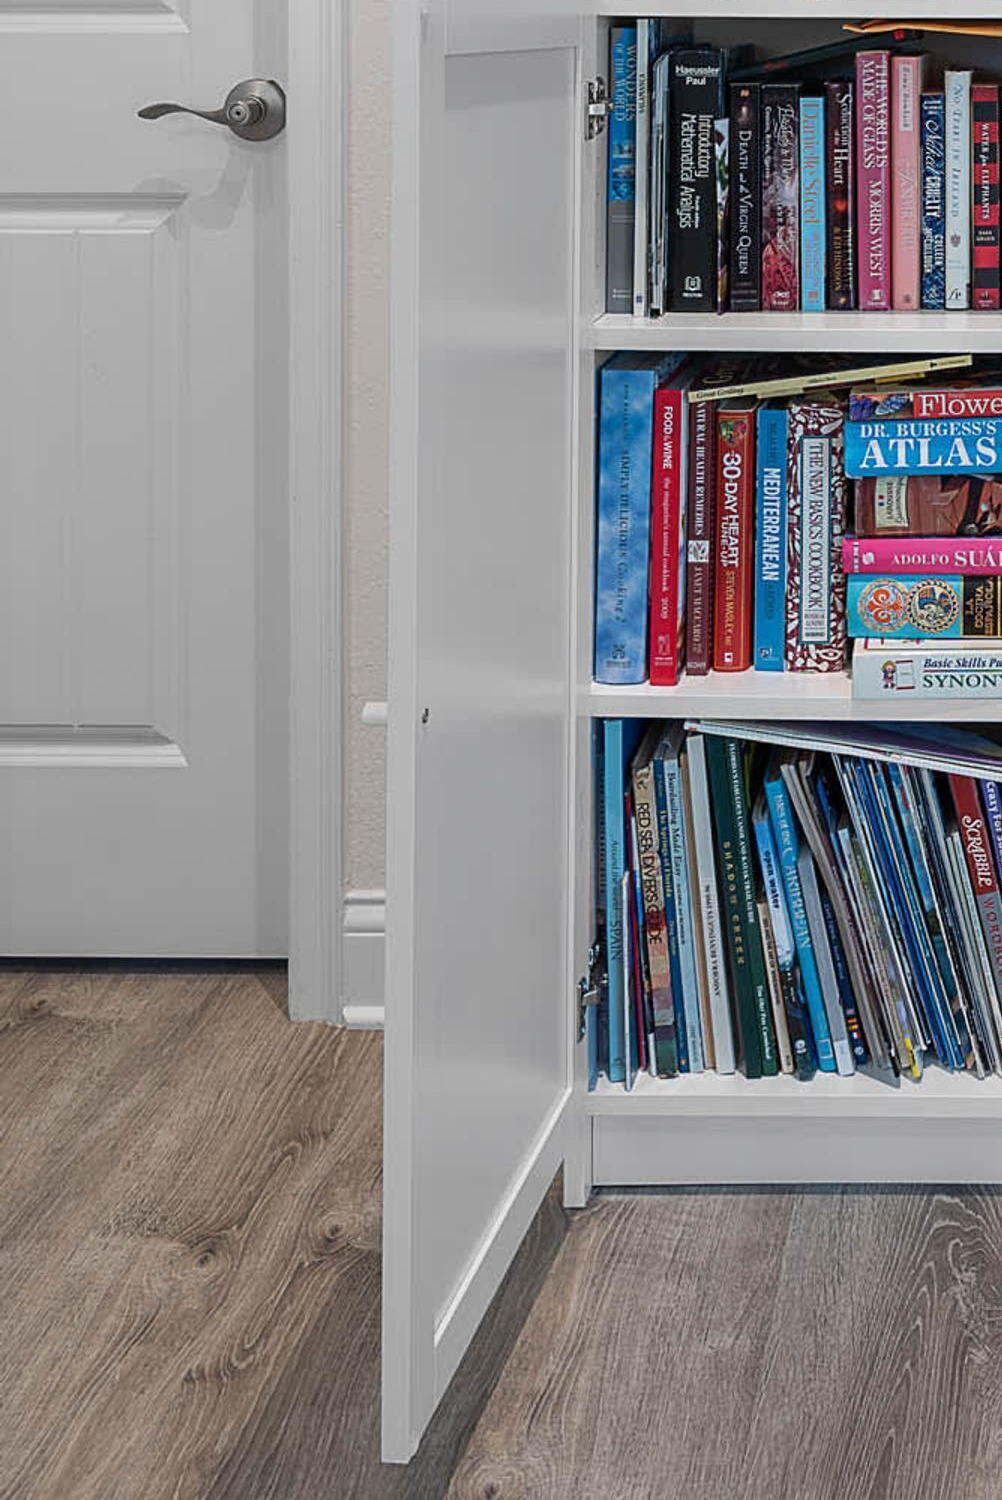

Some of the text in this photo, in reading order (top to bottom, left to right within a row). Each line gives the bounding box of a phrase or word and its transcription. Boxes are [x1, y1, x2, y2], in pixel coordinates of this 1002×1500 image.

[614, 79, 626, 121] WORLD
[686, 77, 706, 86] Paul
[803, 103, 821, 174] Danielle
[836, 94, 853, 145] Seduction
[863, 60, 875, 168] MADE OF GLASS
[876, 63, 888, 168] THE WORLD IS
[677, 113, 696, 228] Mathematical Analysis
[694, 114, 712, 177] Introductory
[833, 148, 849, 185] Heart
[925, 120, 944, 218] Naked CRUELTY
[736, 130, 752, 274] DEATH VIRGIN QUEEN
[803, 178, 822, 224] Steel
[870, 180, 882, 277] MORRIS WEST
[662, 406, 673, 469] FOOD WINE
[860, 436, 998, 468] ATLAS
[861, 421, 997, 438] DR. BURGESS'S
[695, 446, 705, 536] HEALTH REMEDIES
[720, 515, 729, 568] TUNE-UP
[728, 515, 739, 569] HEART
[762, 468, 781, 581] MEDITERRANEAN
[808, 443, 823, 608] THE NEW BASICS COOKBOOK
[892, 554, 949, 566] ADOLFO
[924, 658, 952, 670] Basic
[955, 658, 987, 670] Skills
[638, 802, 651, 828] RED
[985, 781, 1000, 812] Crazy
[993, 814, 1002, 832] For
[762, 850, 781, 909] open water
[610, 920, 624, 961] SPAIN
